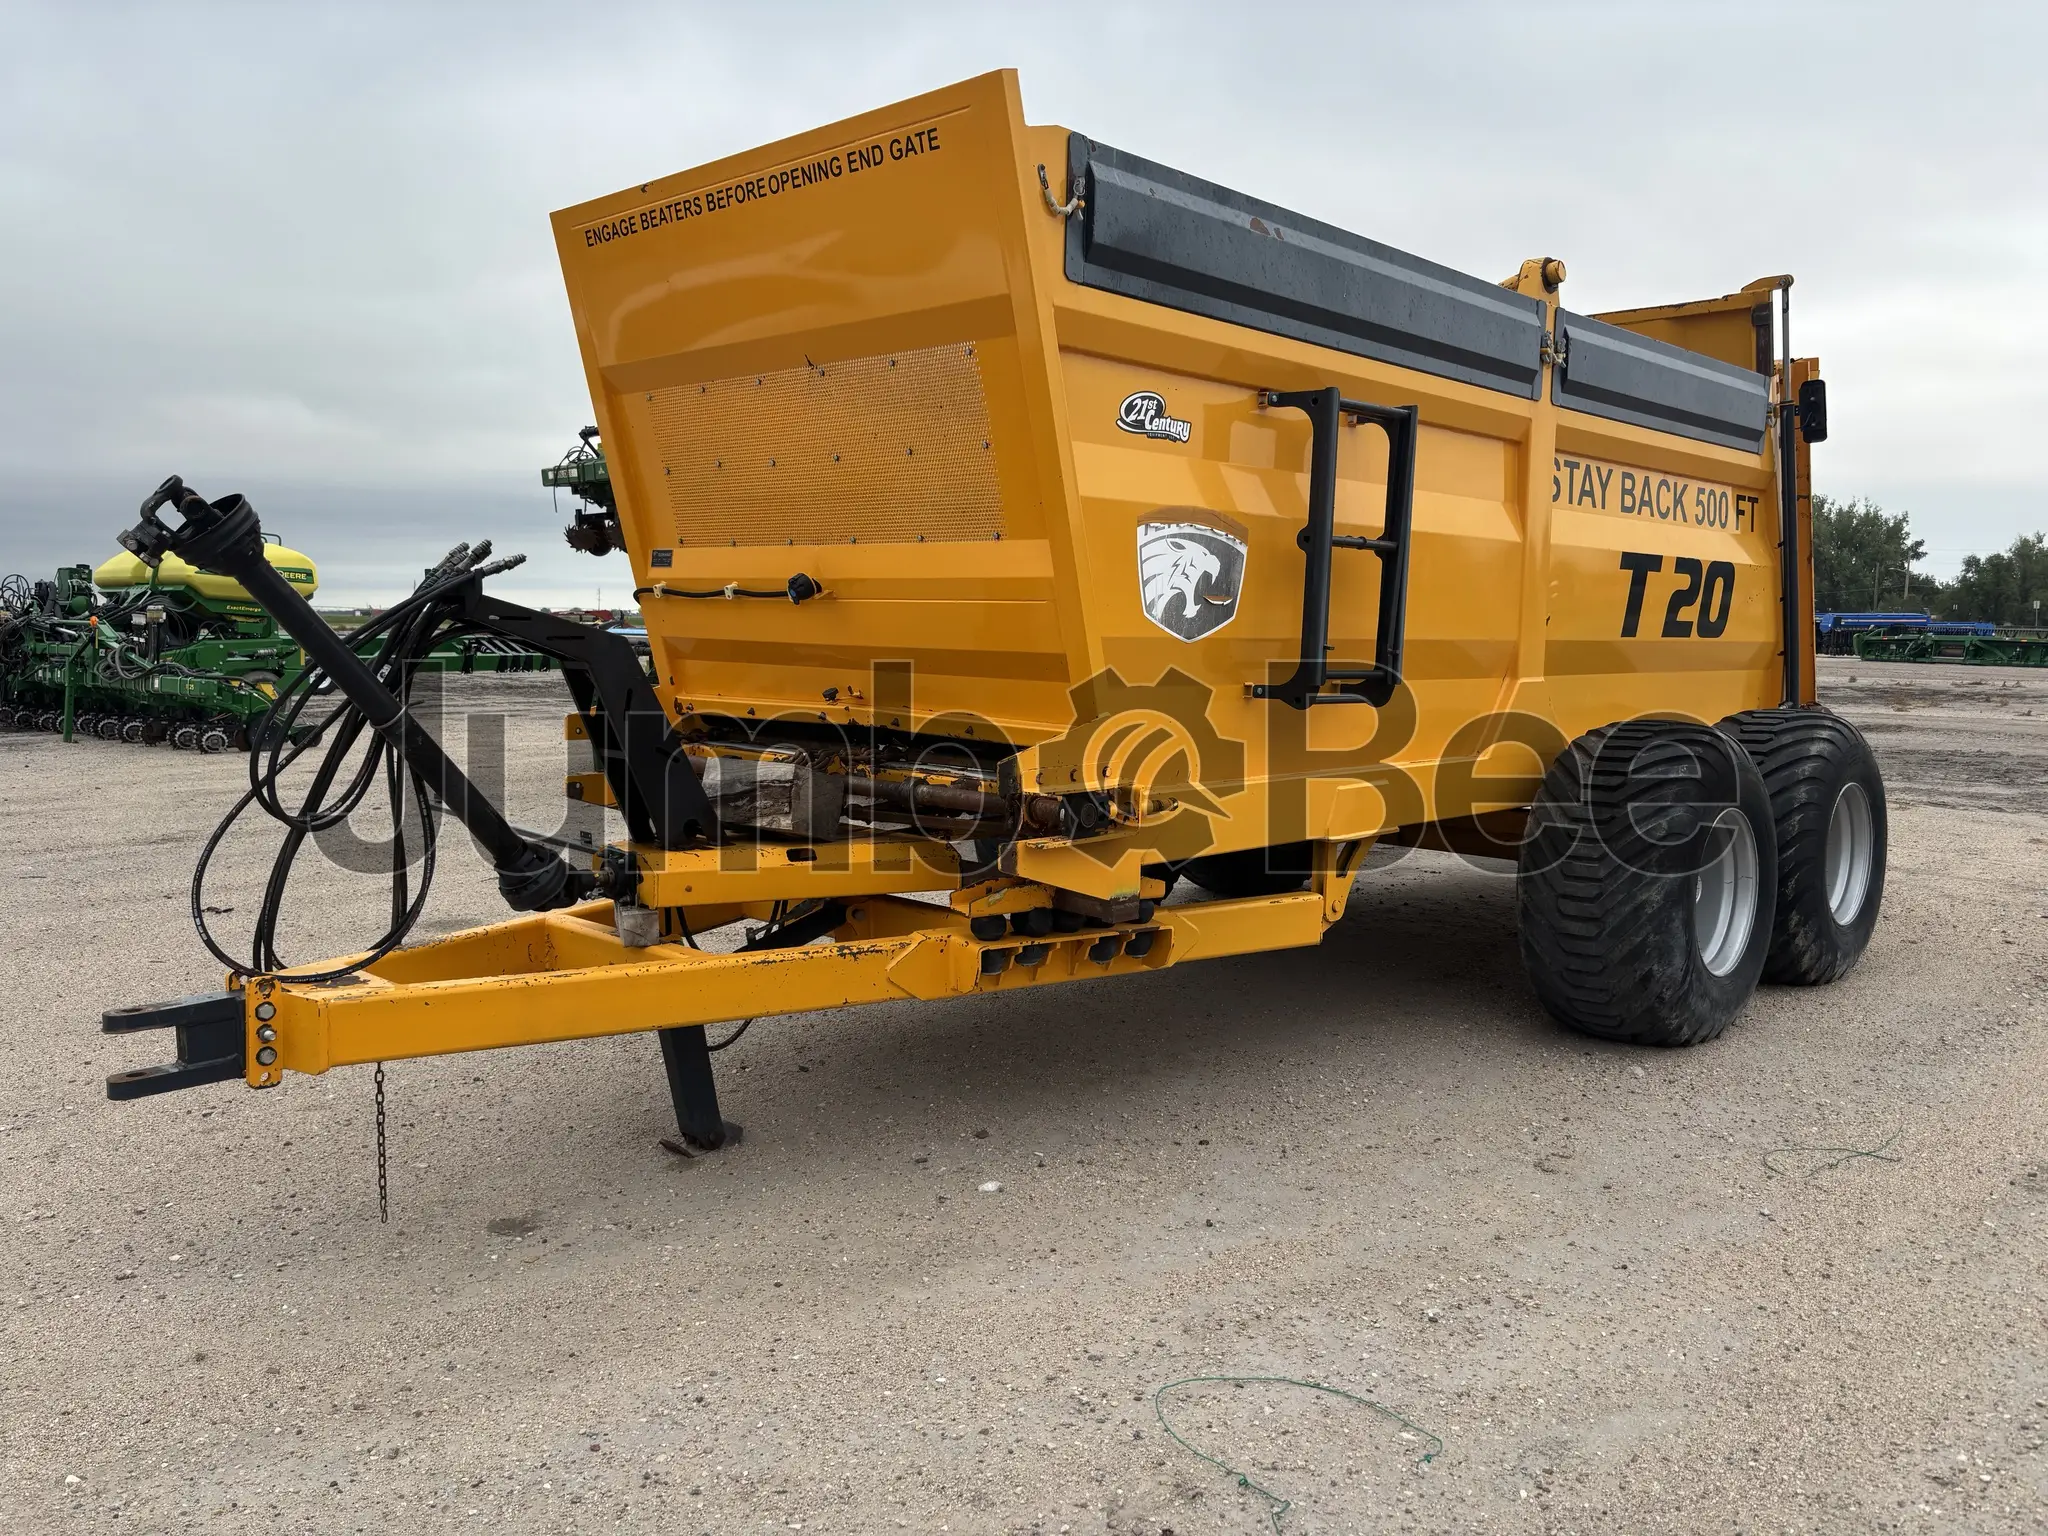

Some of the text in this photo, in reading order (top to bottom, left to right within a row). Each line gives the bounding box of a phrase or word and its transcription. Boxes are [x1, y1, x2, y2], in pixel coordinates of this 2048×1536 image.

[585, 128, 941, 247] ENGAGE BEATERS BEFORE OPENING END GATE
[1128, 398, 1157, 420] 21st
[1620, 472, 1688, 523] BACK
[1695, 487, 1728, 530] 500
[1736, 494, 1759, 532] FT
[1619, 551, 1736, 638] T 20
